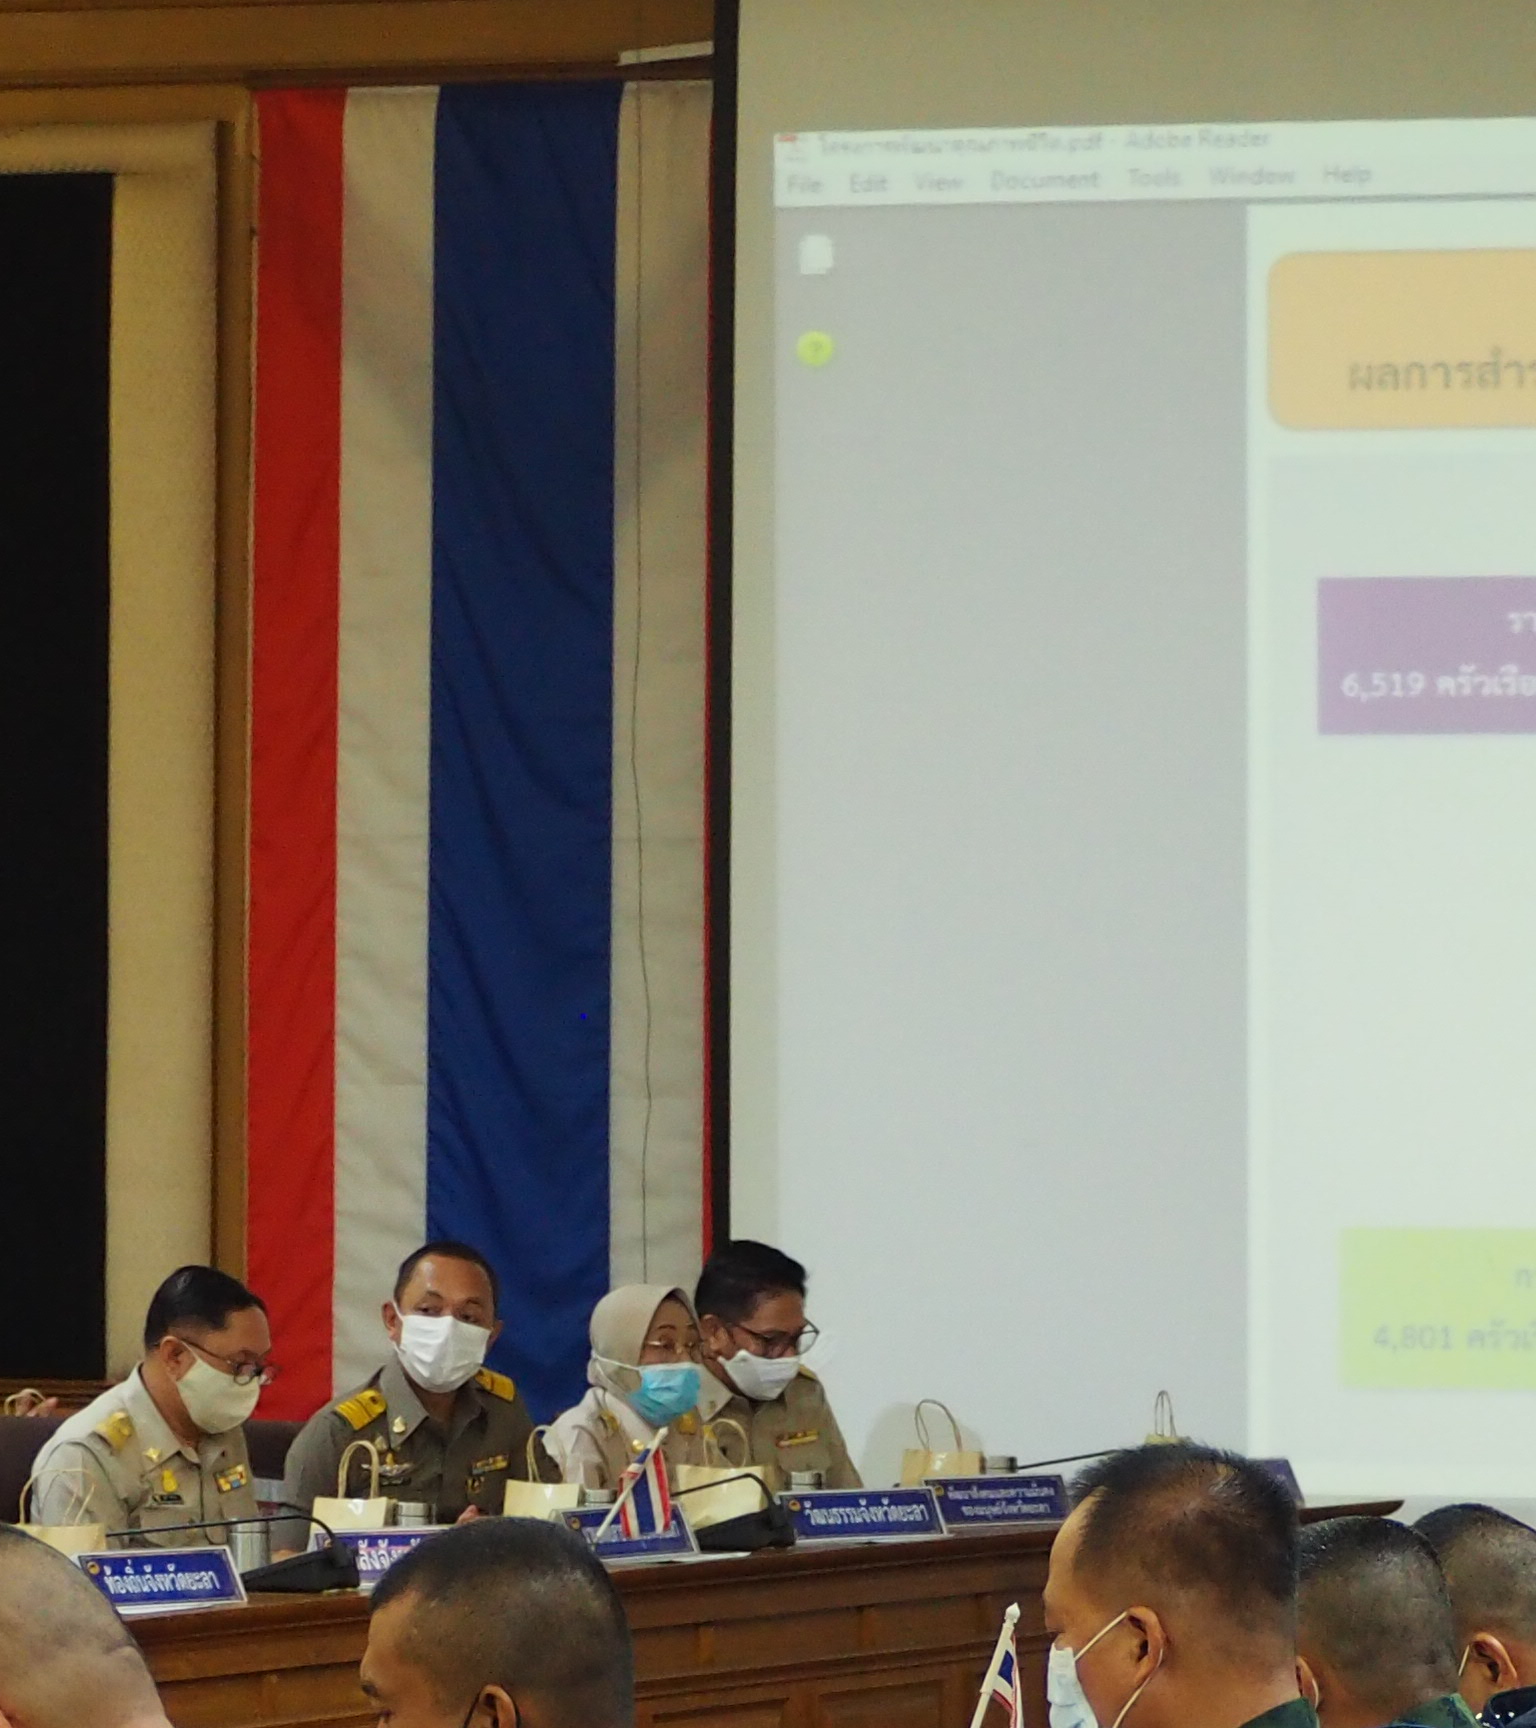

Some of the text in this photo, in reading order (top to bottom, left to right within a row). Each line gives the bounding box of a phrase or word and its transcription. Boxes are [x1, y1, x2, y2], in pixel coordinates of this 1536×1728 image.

[989, 168, 1100, 191] Document
[1340, 671, 1427, 702] 6,519
[1372, 1324, 1453, 1355] 4,801
